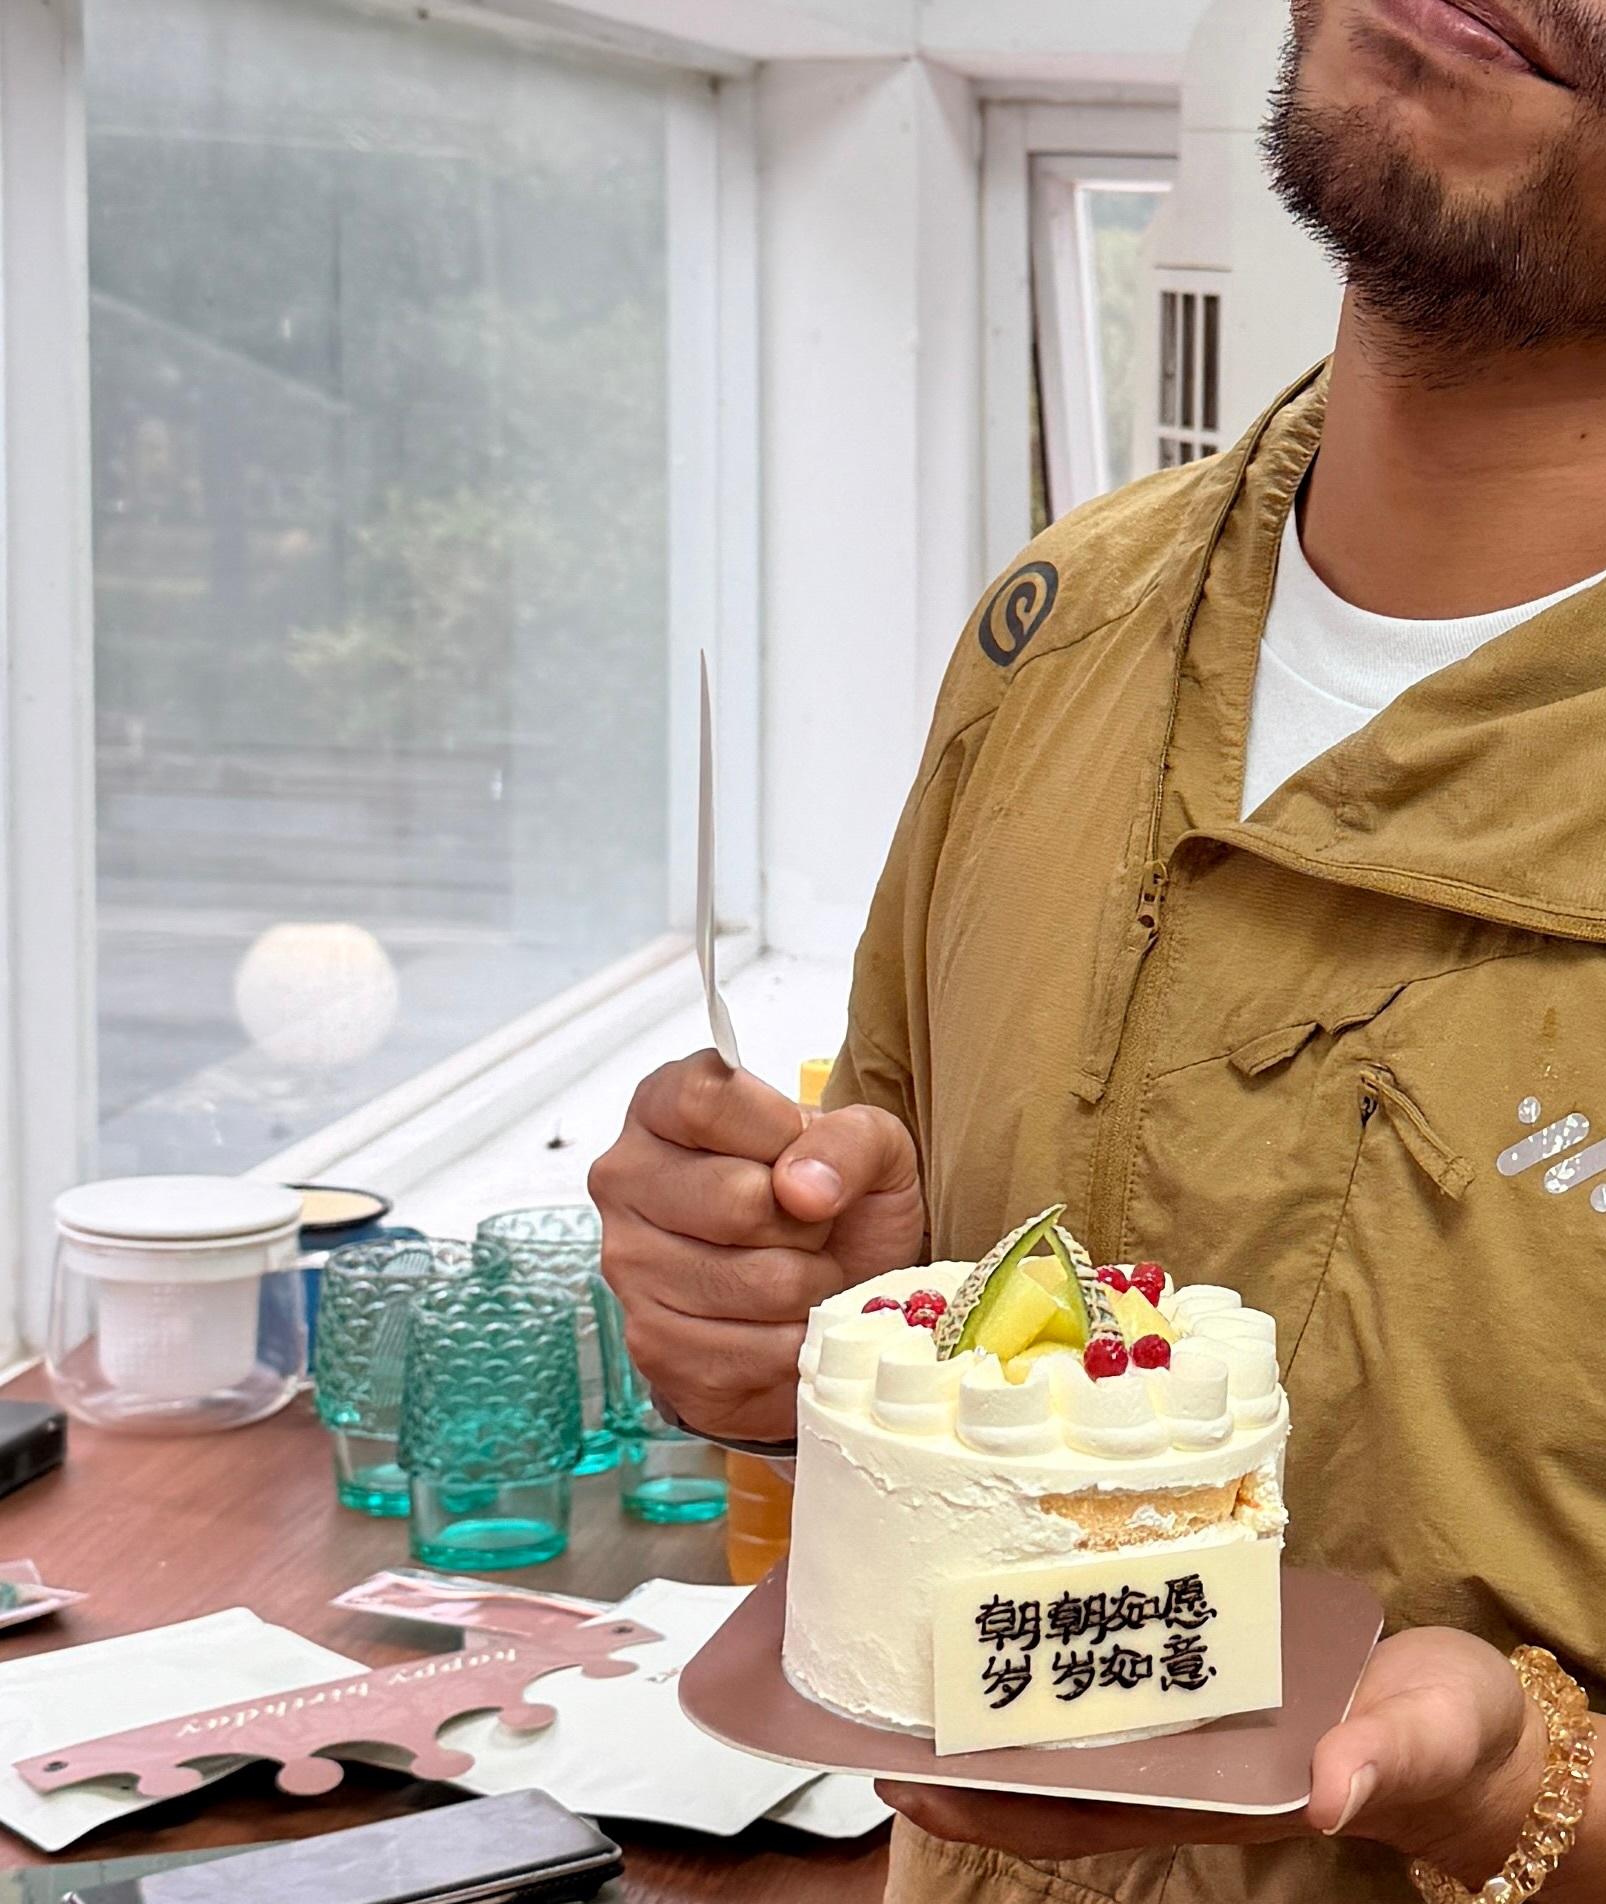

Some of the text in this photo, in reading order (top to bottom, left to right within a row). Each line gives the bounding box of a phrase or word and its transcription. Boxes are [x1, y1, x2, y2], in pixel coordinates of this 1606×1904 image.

[975, 1573, 1217, 1651] 朝朝如愿
[175, 1648, 517, 1739] happy birthday
[981, 1634, 1217, 1709] 岁岁如意
